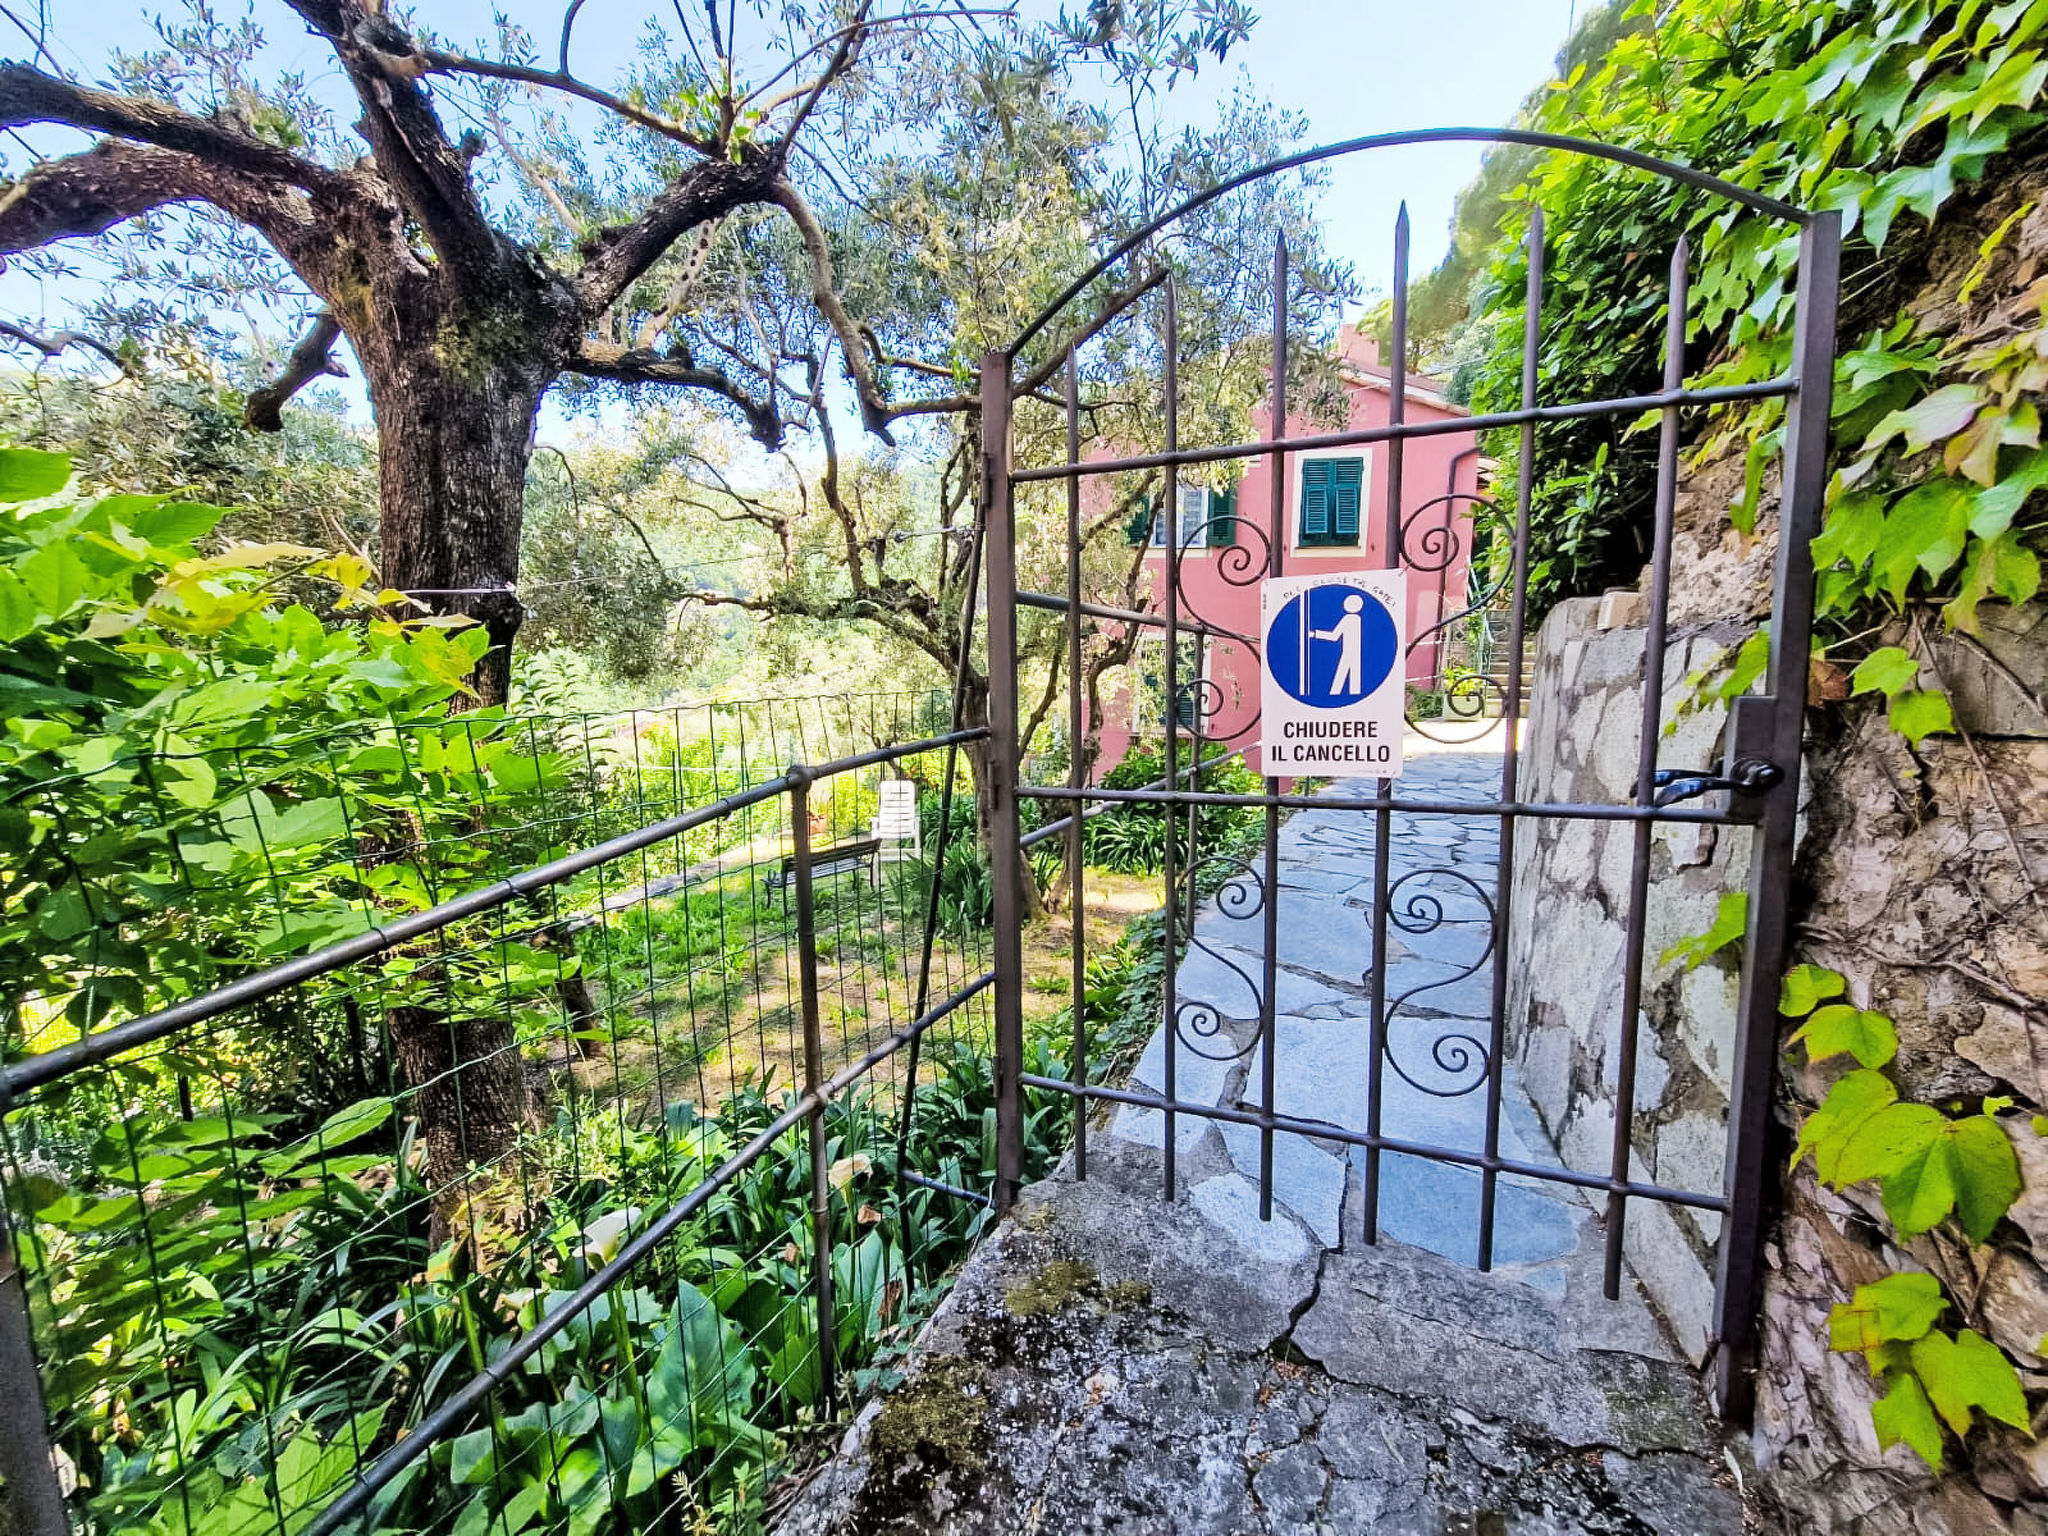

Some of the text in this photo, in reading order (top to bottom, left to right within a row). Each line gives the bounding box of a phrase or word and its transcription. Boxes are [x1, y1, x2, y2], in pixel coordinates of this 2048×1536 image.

[1283, 721, 1378, 738] CHIUDERE
[1272, 745, 1390, 762] IL CANCELLO
